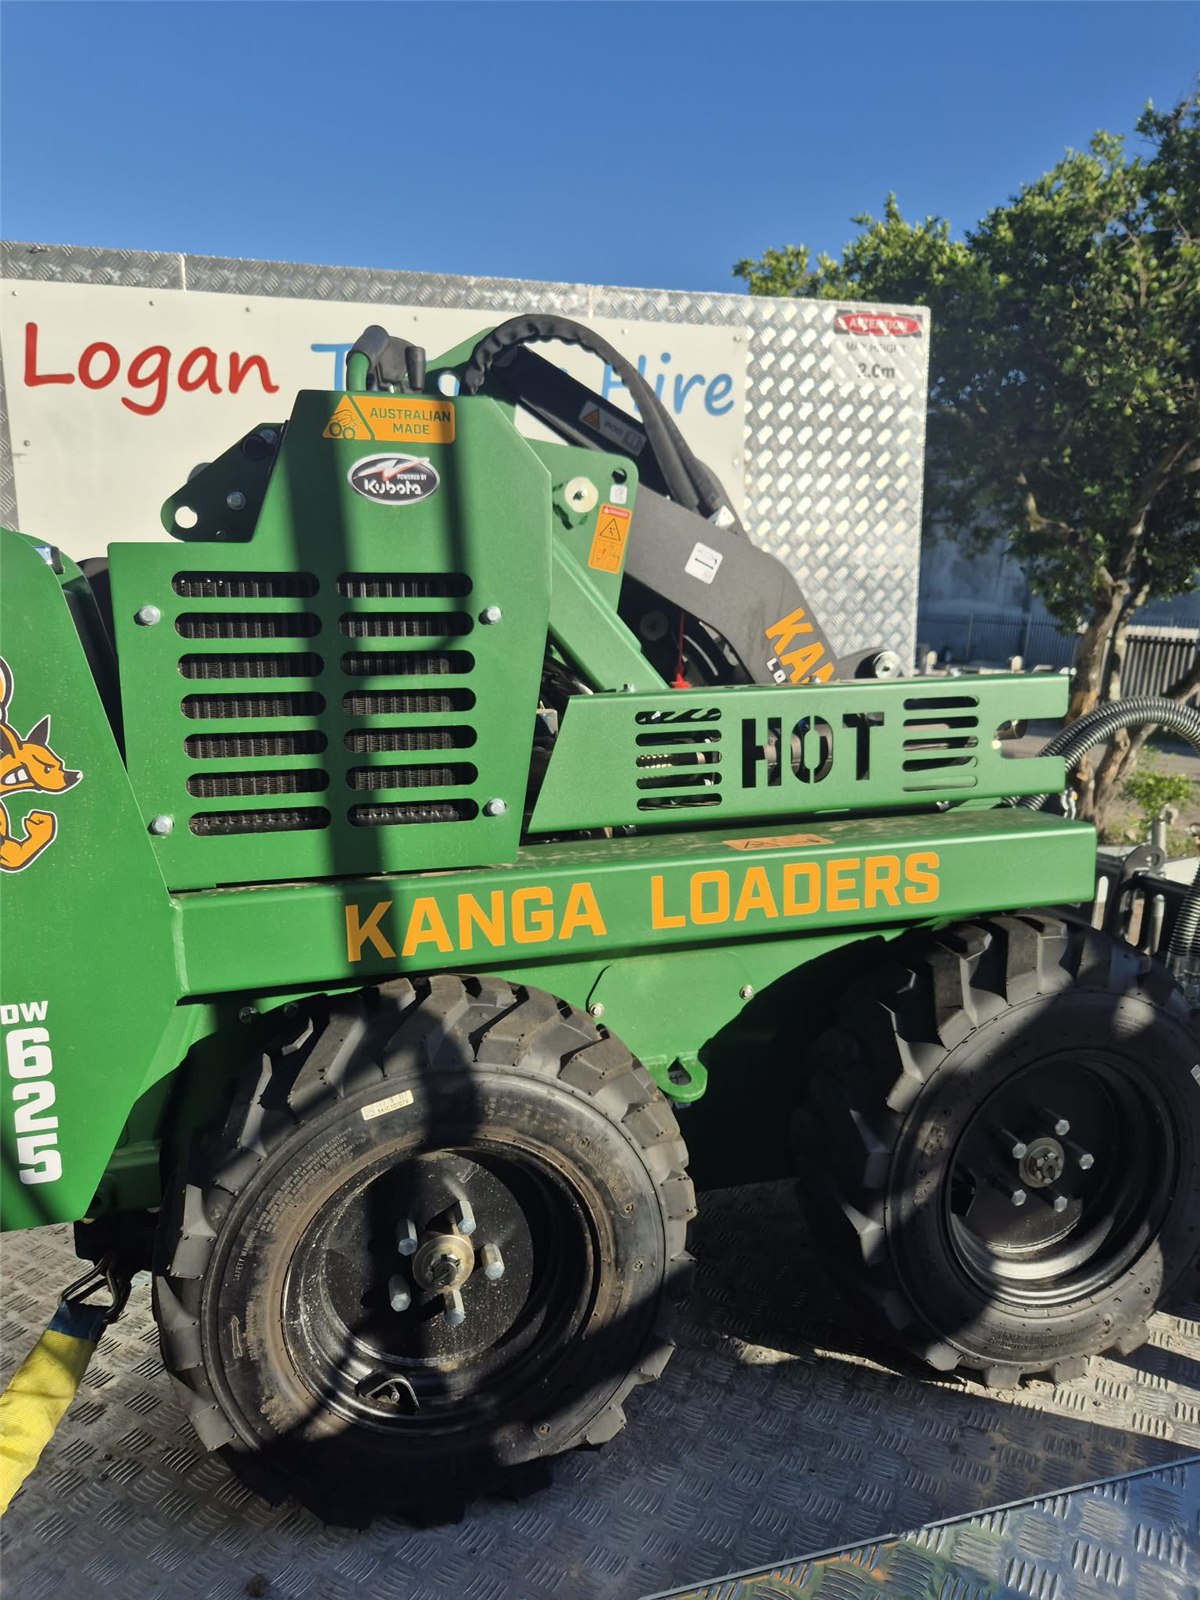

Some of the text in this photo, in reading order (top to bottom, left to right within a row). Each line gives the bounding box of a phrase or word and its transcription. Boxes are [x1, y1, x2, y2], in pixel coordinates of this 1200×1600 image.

[24, 321, 280, 417] Logan
[600, 351, 735, 417] Hire
[370, 407, 451, 422] AUSTRALIAN
[392, 423, 431, 434] MADE
[363, 479, 422, 495] Kubota
[397, 473, 420, 481] POWERED
[741, 711, 885, 789] HOT
[345, 852, 940, 962] KANGA LOADERS
[0, 1000, 49, 1025] DW
[6, 1027, 62, 1185] 625
